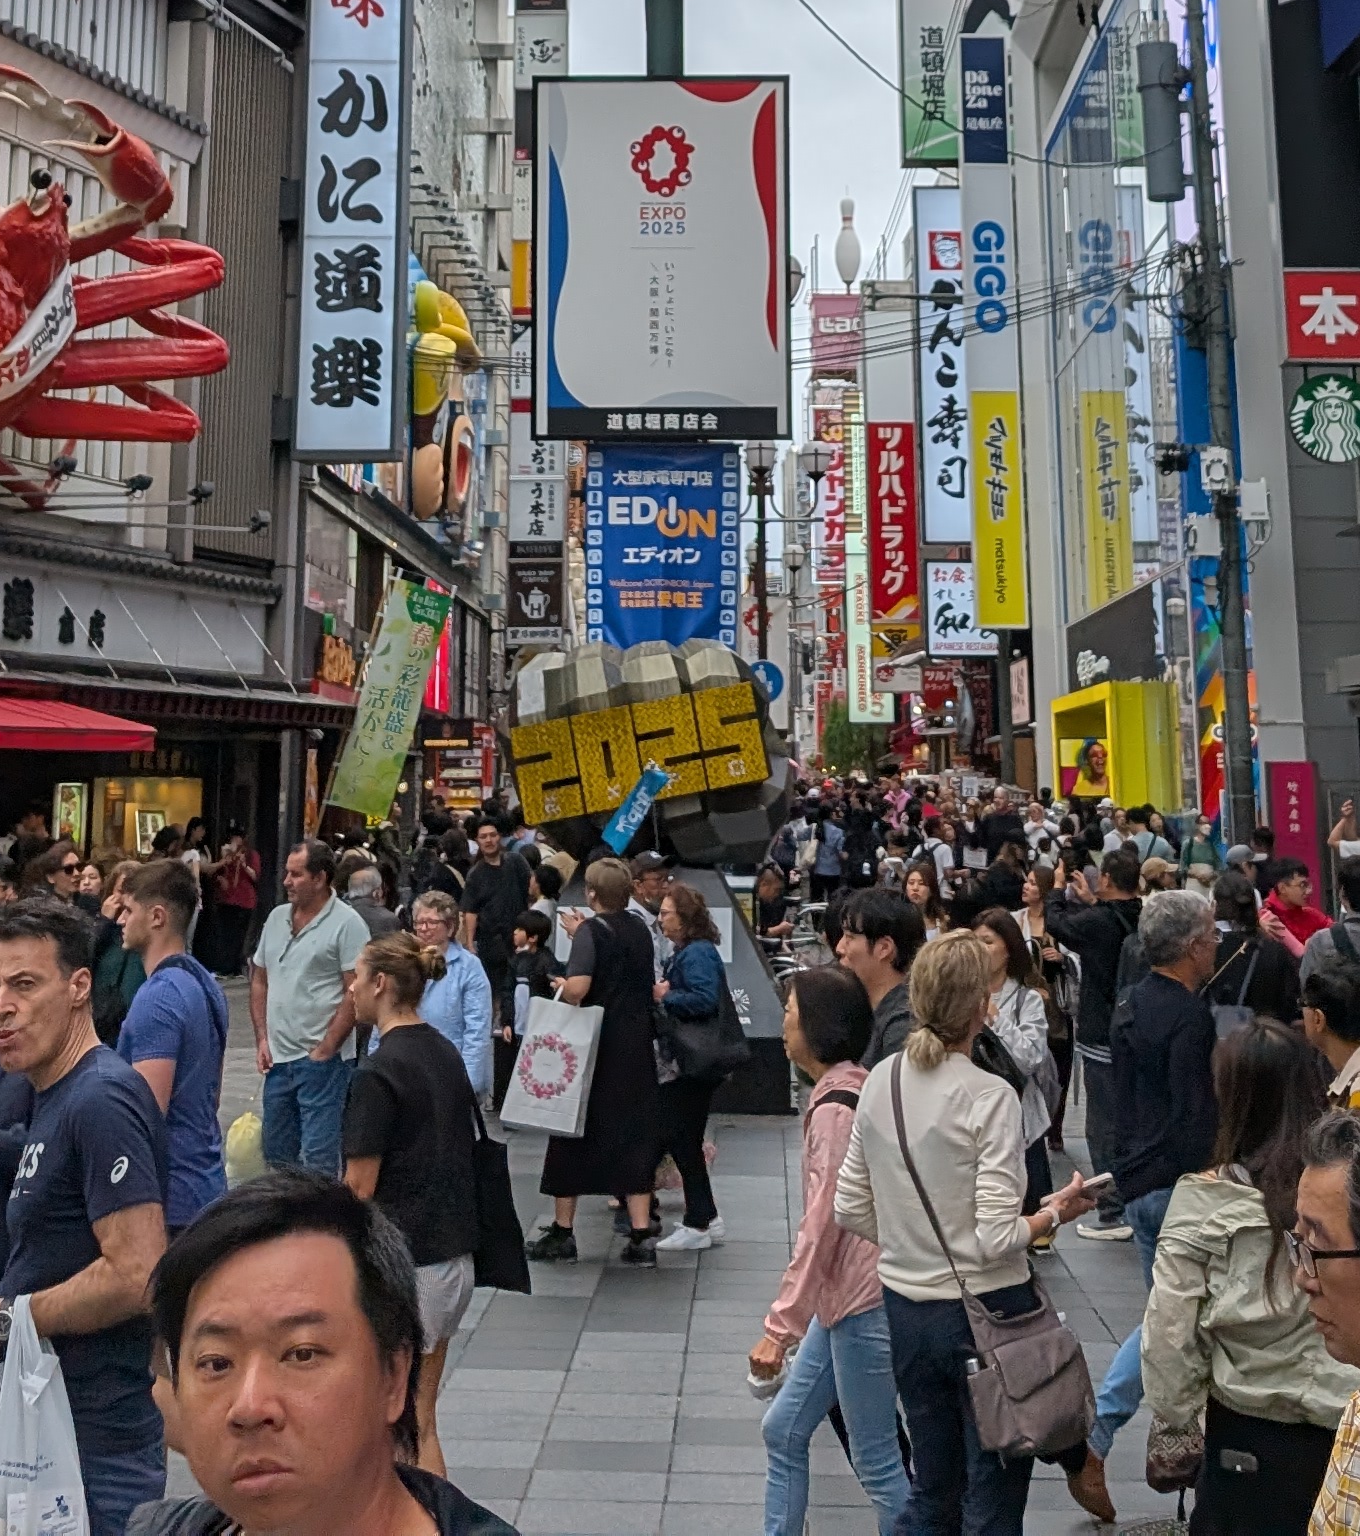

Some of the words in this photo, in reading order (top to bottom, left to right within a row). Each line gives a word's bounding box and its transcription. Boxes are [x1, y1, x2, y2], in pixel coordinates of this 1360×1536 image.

[965, 84, 1003, 96] tone
[965, 95, 988, 108] Za
[639, 206, 687, 220] EXPO
[640, 221, 686, 235] 2025
[311, 68, 389, 411] かに道楽
[972, 220, 1007, 334] GiGO
[1299, 286, 1360, 346] 本
[606, 413, 719, 431] 道頓堀商店会
[984, 416, 1010, 522] マツモトキヨシ
[612, 470, 713, 488] 大型家電専門店
[607, 495, 717, 539] EDION
[877, 426, 910, 595] ツルハドラッグ
[622, 547, 701, 565] エディオン
[933, 567, 973, 583] お食
[994, 537, 1007, 605] matsukiyo
[855, 573, 864, 625] KARAOKE
[933, 641, 964, 651] JAPANESE
